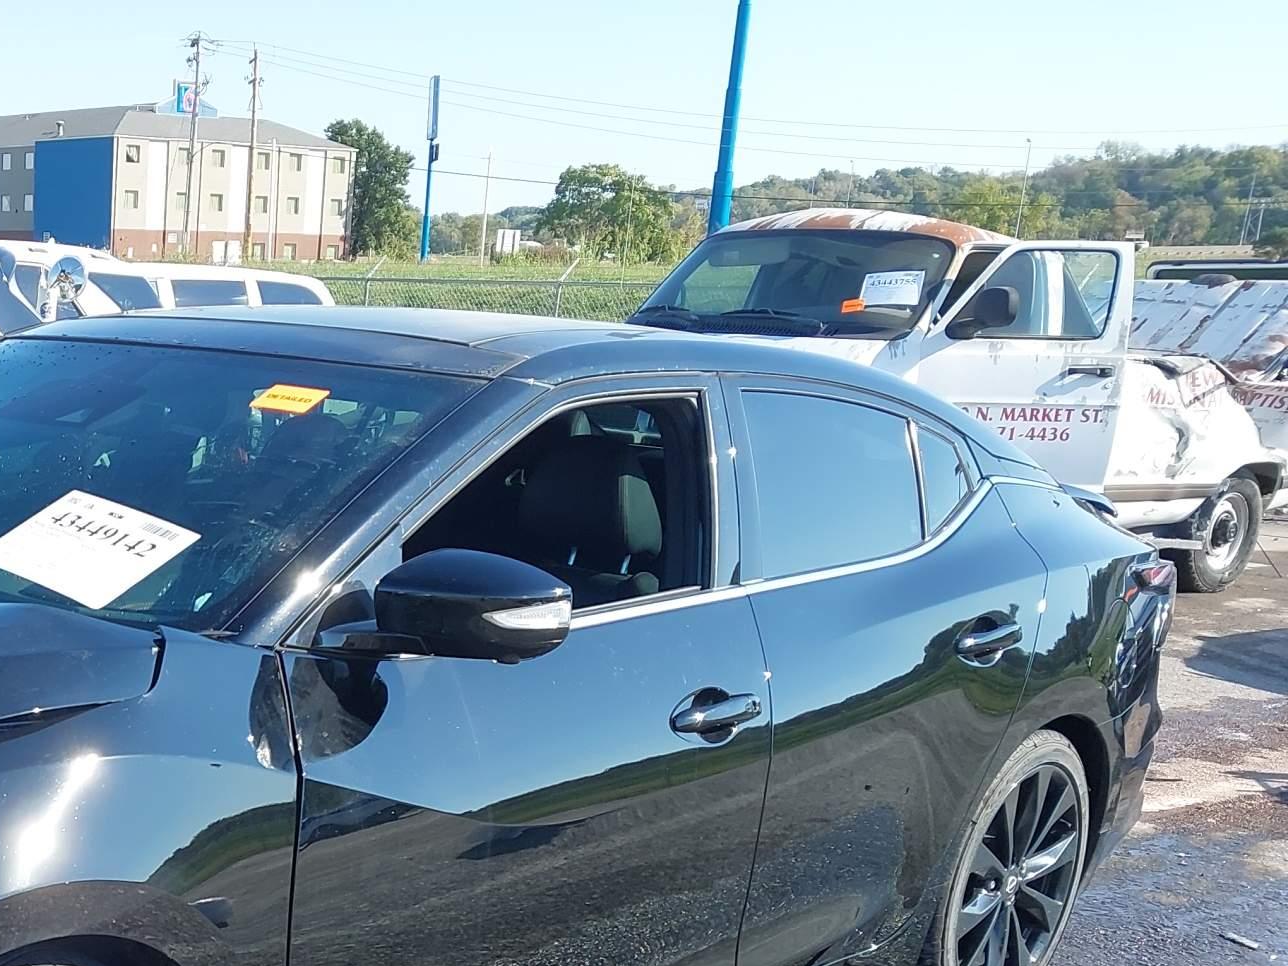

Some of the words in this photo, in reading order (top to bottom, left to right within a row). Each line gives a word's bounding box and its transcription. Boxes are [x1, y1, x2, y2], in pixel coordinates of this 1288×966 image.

[975, 406, 993, 422] N.
[999, 407, 1075, 423] MARKET
[1079, 408, 1104, 424] ST.
[997, 426, 1071, 442] 71-4436
[51, 511, 158, 558] 43449142
